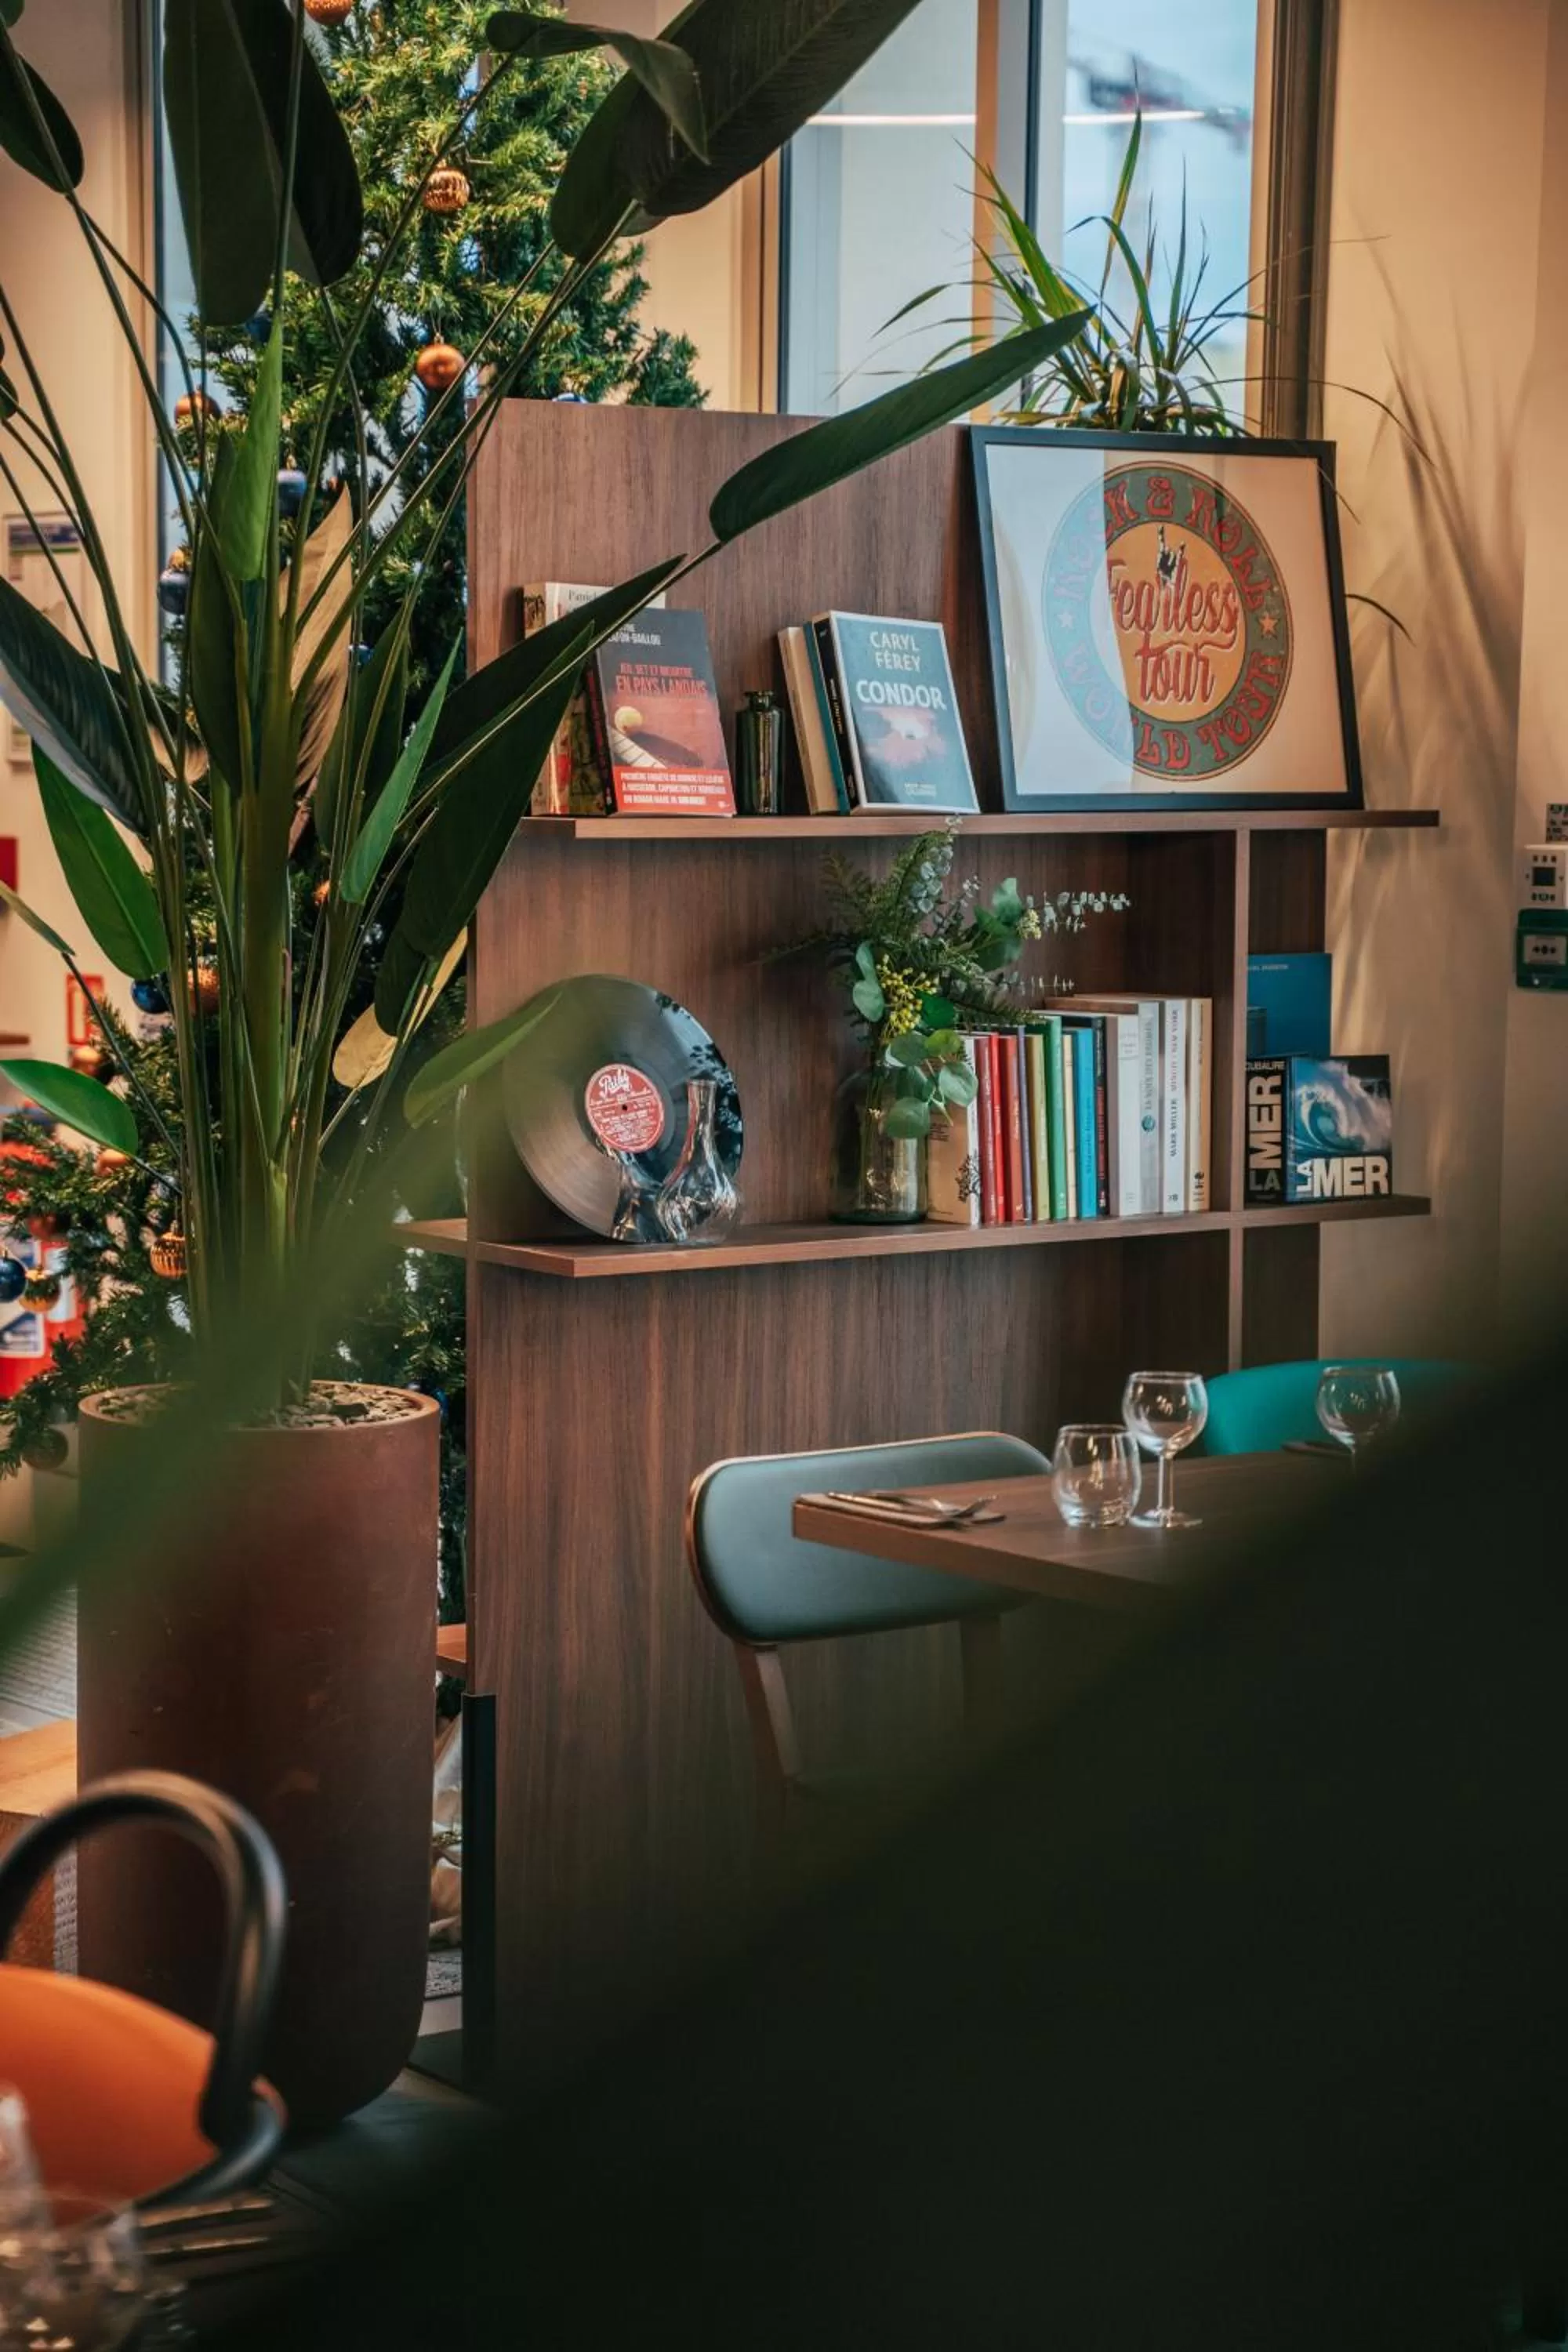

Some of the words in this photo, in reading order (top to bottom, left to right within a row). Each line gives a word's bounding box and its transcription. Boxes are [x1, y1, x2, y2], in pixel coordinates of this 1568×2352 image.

[869, 631, 920, 652] CARYL
[875, 650, 920, 672] FÉREY
[1135, 630, 1214, 703] tour
[856, 680, 947, 710] CONDOR
[1249, 1075, 1282, 1169] MER
[1249, 1169, 1280, 1190] LA
[1296, 1160, 1312, 1192] LA
[1313, 1156, 1389, 1198] MER
